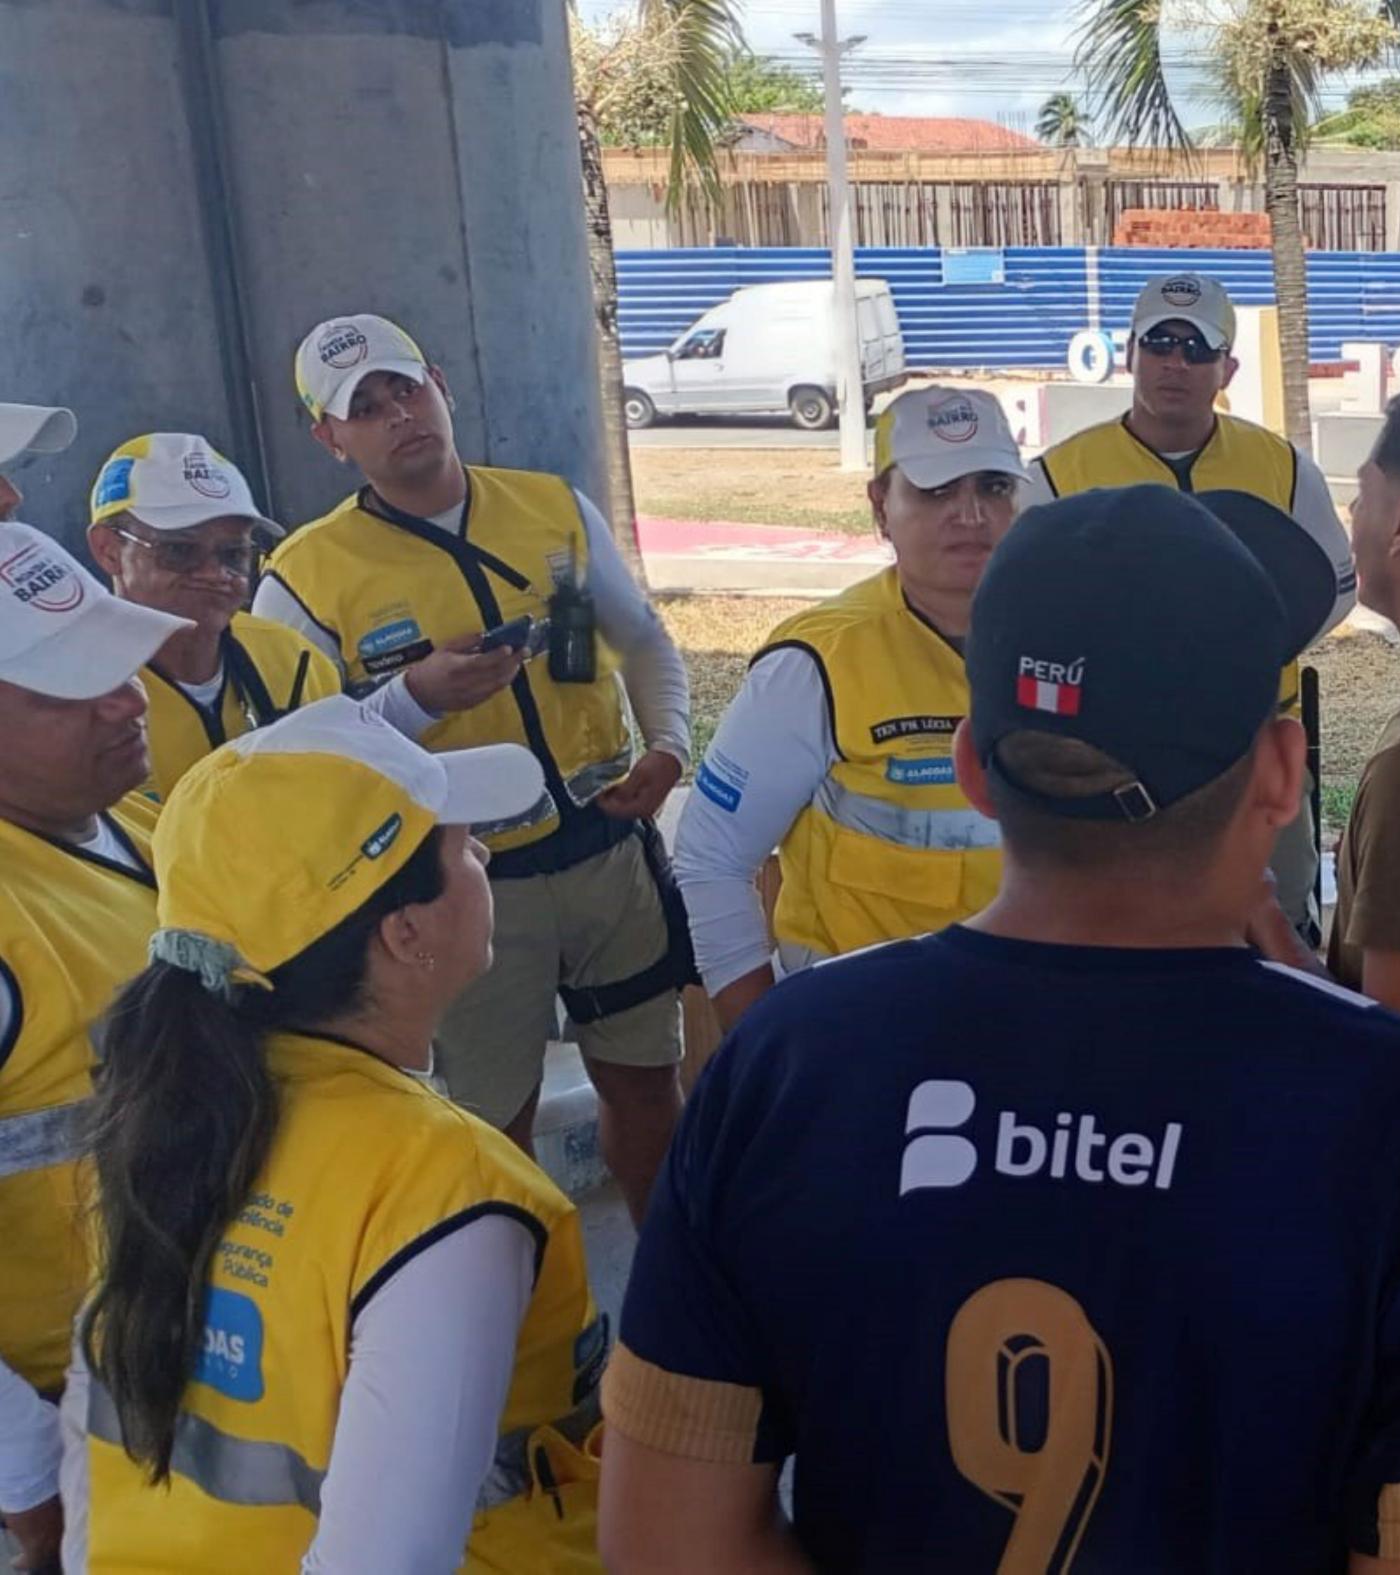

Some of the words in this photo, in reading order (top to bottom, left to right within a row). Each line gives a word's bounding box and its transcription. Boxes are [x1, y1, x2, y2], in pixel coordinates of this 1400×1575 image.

[321, 334, 366, 362] BAIRRO
[1019, 656, 1086, 685] PERÚ
[995, 1111, 1183, 1190] bitel
[276, 1200, 294, 1217] de
[223, 1258, 269, 1287] Pública
[945, 1277, 1113, 1575] 9
